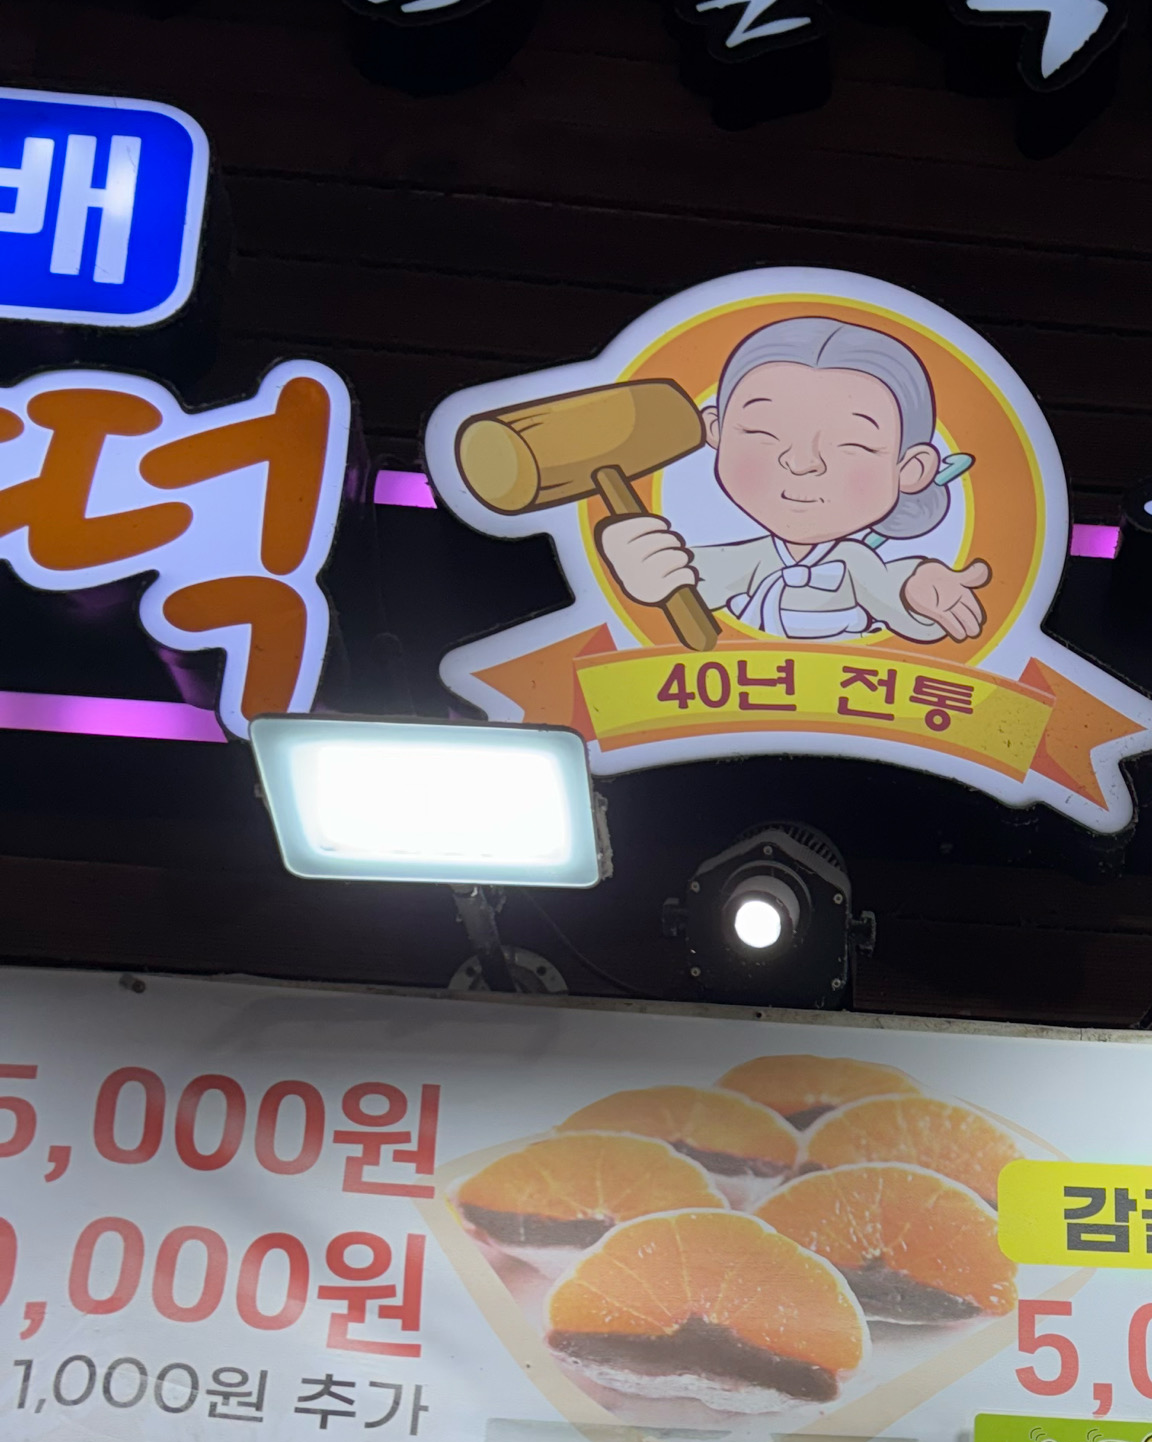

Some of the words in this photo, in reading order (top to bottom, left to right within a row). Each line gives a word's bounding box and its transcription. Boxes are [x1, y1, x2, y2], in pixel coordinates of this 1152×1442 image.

[657, 659, 796, 714] 40년
[837, 665, 974, 733] 전통
[0, 1215, 427, 1358] ,000원
[11, 1353, 269, 1422] 1,000원
[293, 1373, 429, 1437] 추가
